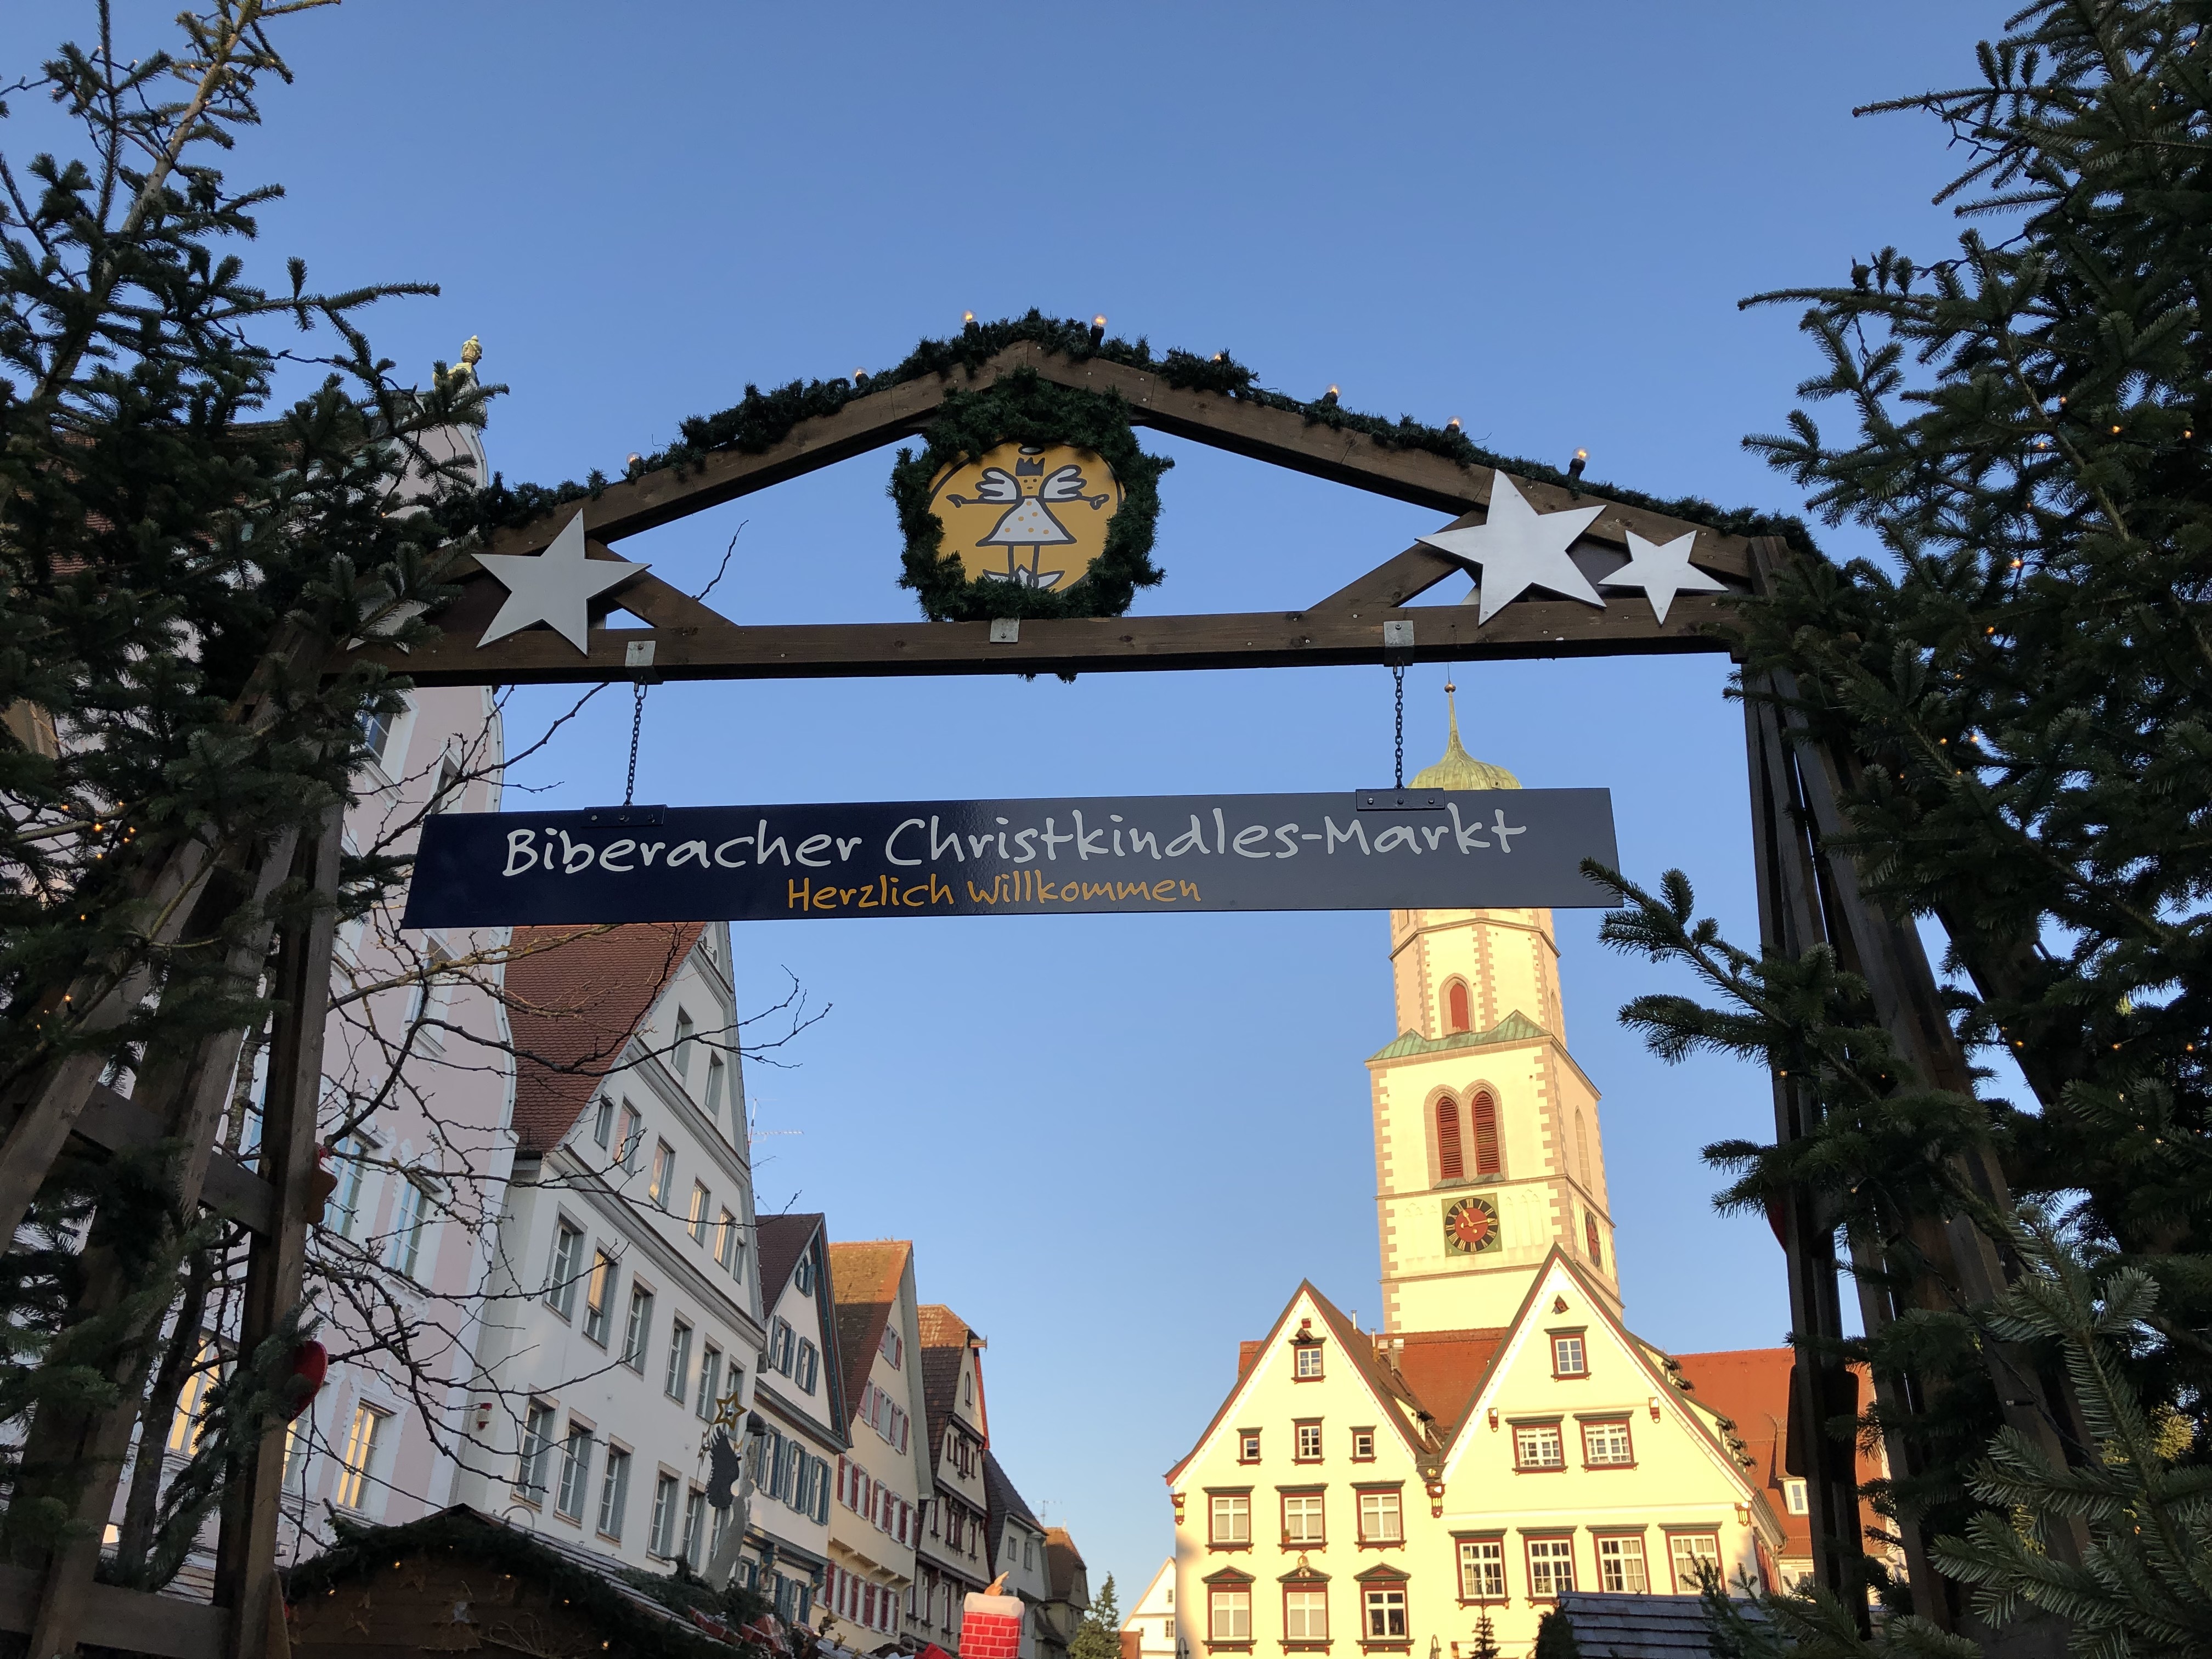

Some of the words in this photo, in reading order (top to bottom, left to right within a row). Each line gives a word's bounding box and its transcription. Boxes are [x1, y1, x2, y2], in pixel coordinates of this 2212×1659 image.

[501, 819, 862, 877] Biberacher
[885, 802, 1527, 866] Christkindles-Markt
[788, 873, 954, 911] Herzlich
